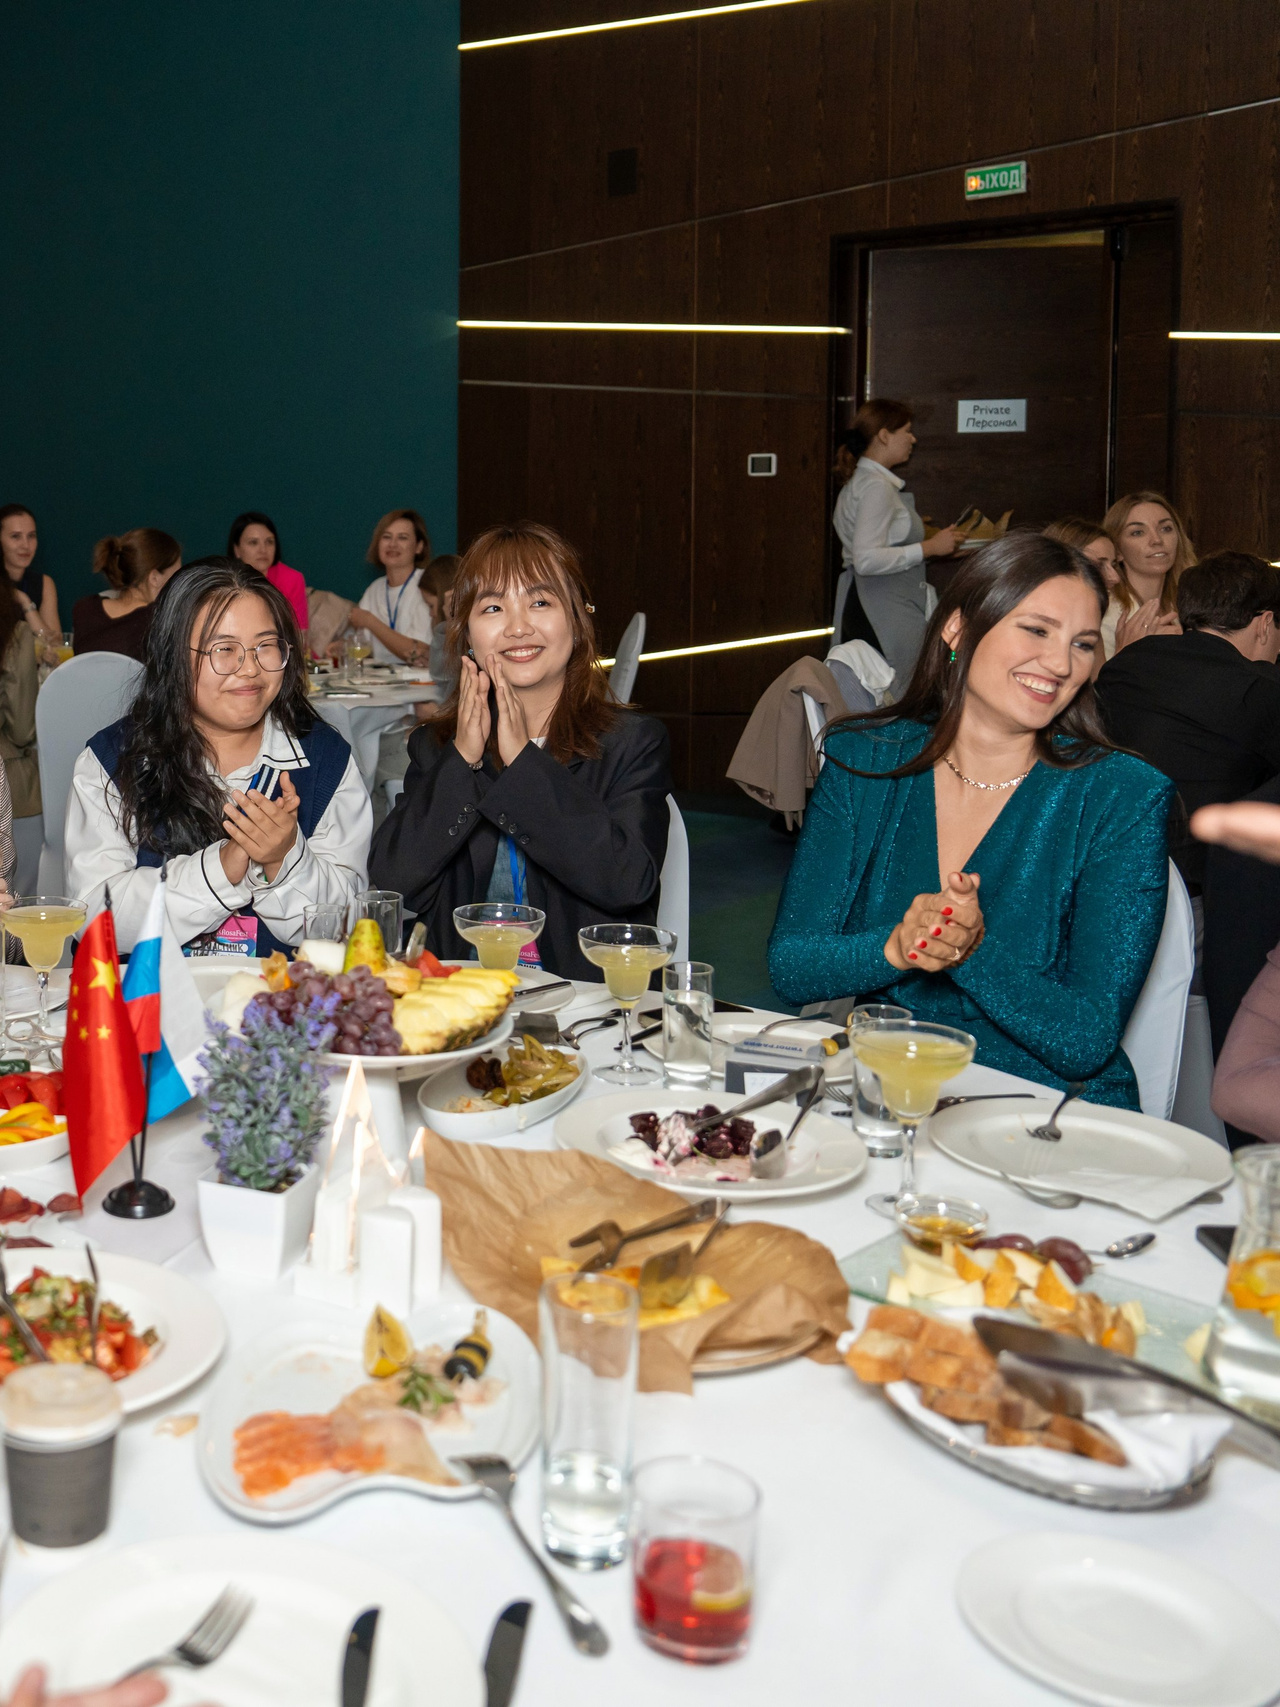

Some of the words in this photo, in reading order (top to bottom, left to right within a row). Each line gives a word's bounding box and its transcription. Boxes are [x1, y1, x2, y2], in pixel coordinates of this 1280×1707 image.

[967, 169, 1020, 191] ВЫХОД
[973, 404, 1011, 415] Private
[966, 417, 1017, 430] Персонал
